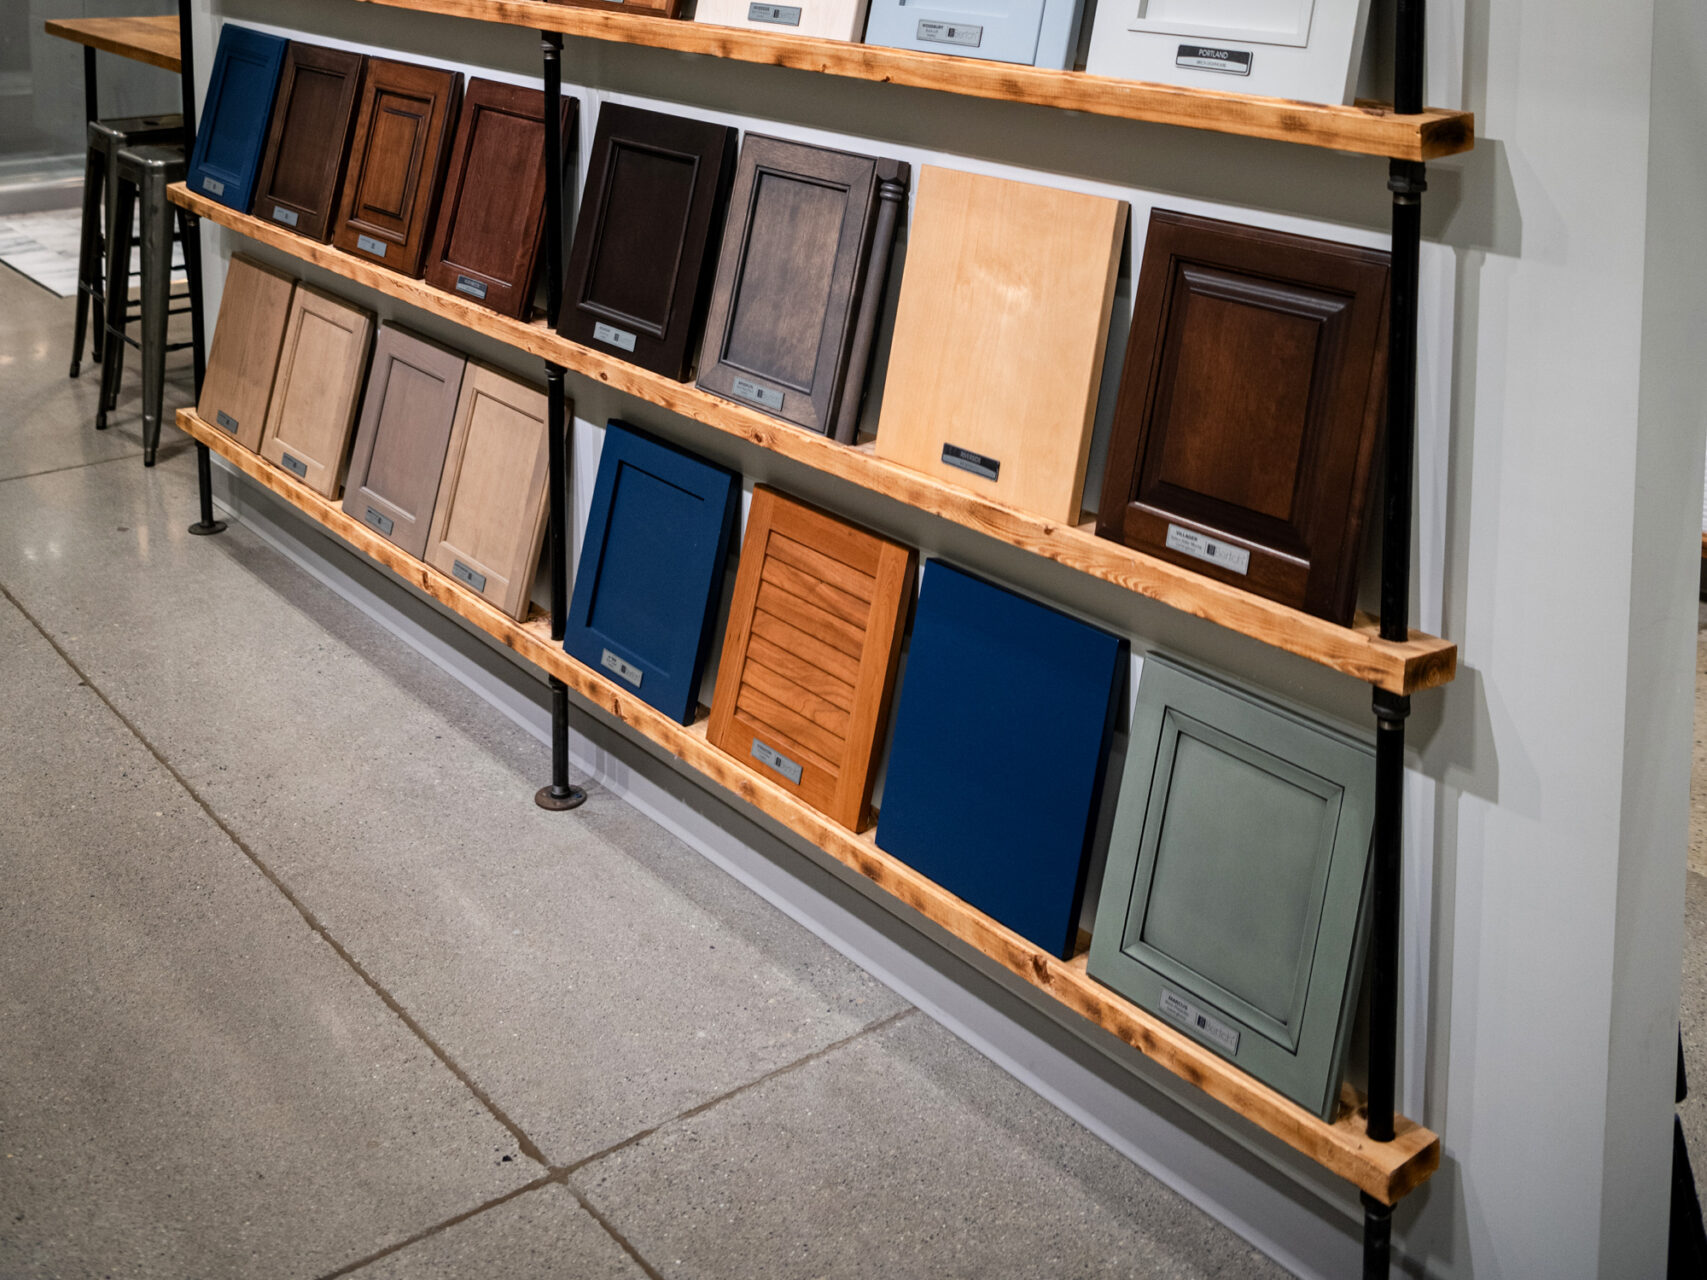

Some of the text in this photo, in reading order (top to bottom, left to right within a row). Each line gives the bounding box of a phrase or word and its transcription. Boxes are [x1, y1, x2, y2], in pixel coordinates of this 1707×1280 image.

[1198, 48, 1229, 59] PORTLAND
[1176, 530, 1198, 542] VILLAGER
[1167, 995, 1188, 1010] MARCUS
